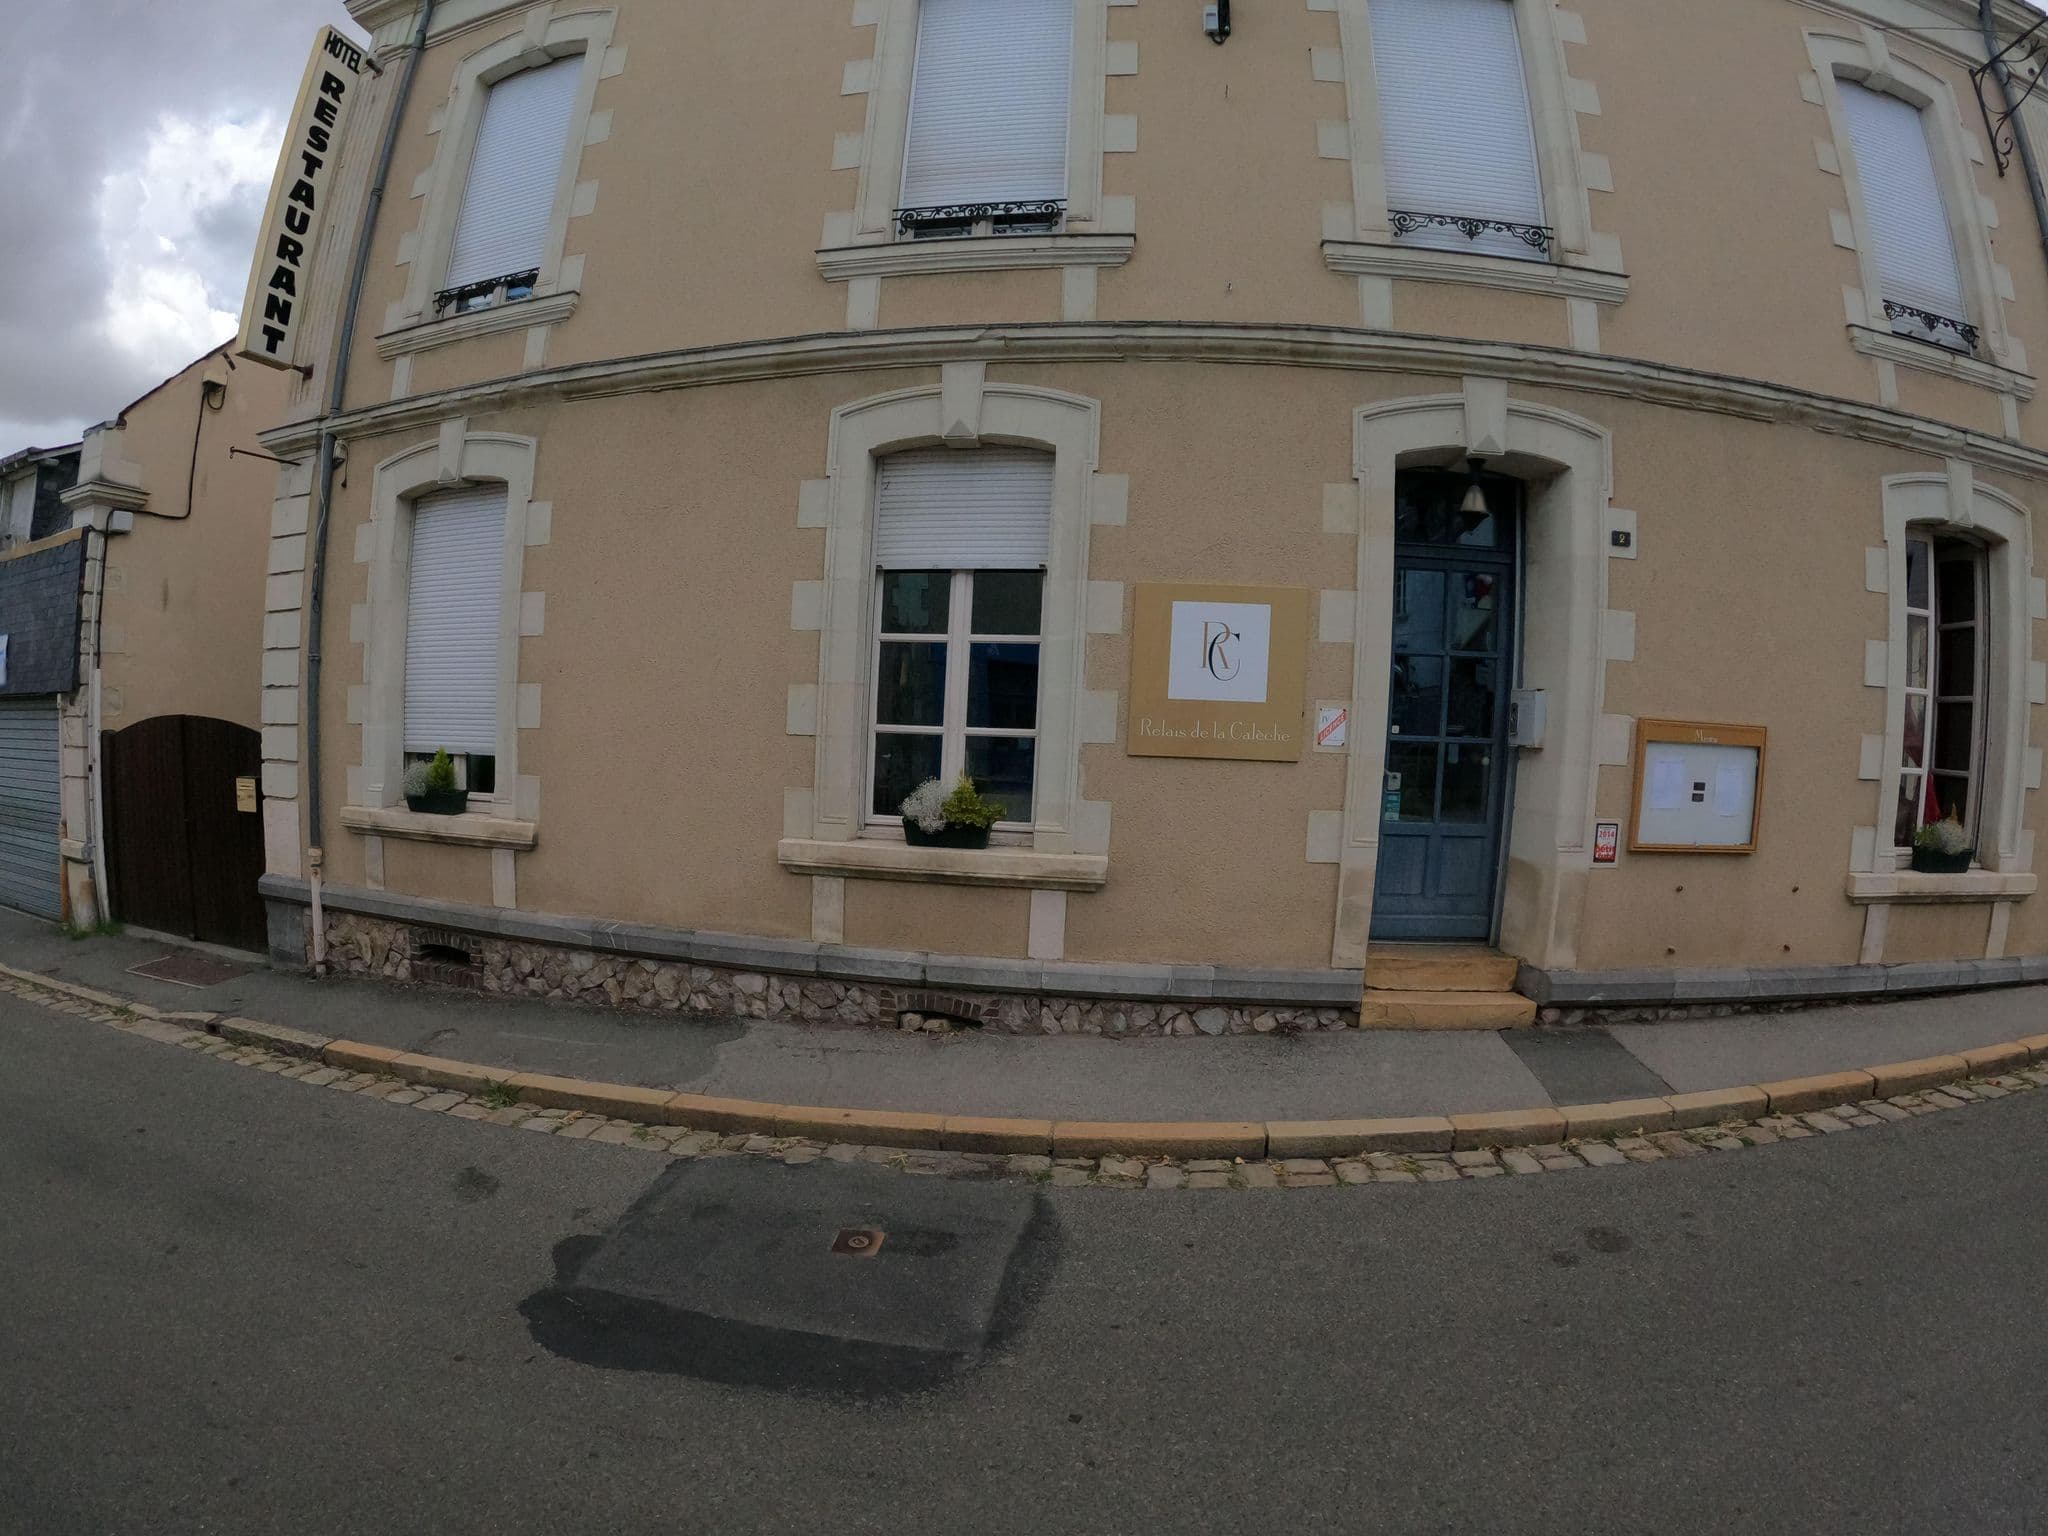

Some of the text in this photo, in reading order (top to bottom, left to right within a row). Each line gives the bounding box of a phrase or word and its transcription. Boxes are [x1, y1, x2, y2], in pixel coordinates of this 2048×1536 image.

[324, 30, 362, 75] HOTEL
[262, 70, 346, 355] RESTAURANT
[1140, 717, 1290, 742] Relais de la Calèche
[1319, 712, 1346, 741] LICENCE
[1599, 830, 1616, 838] 2014
